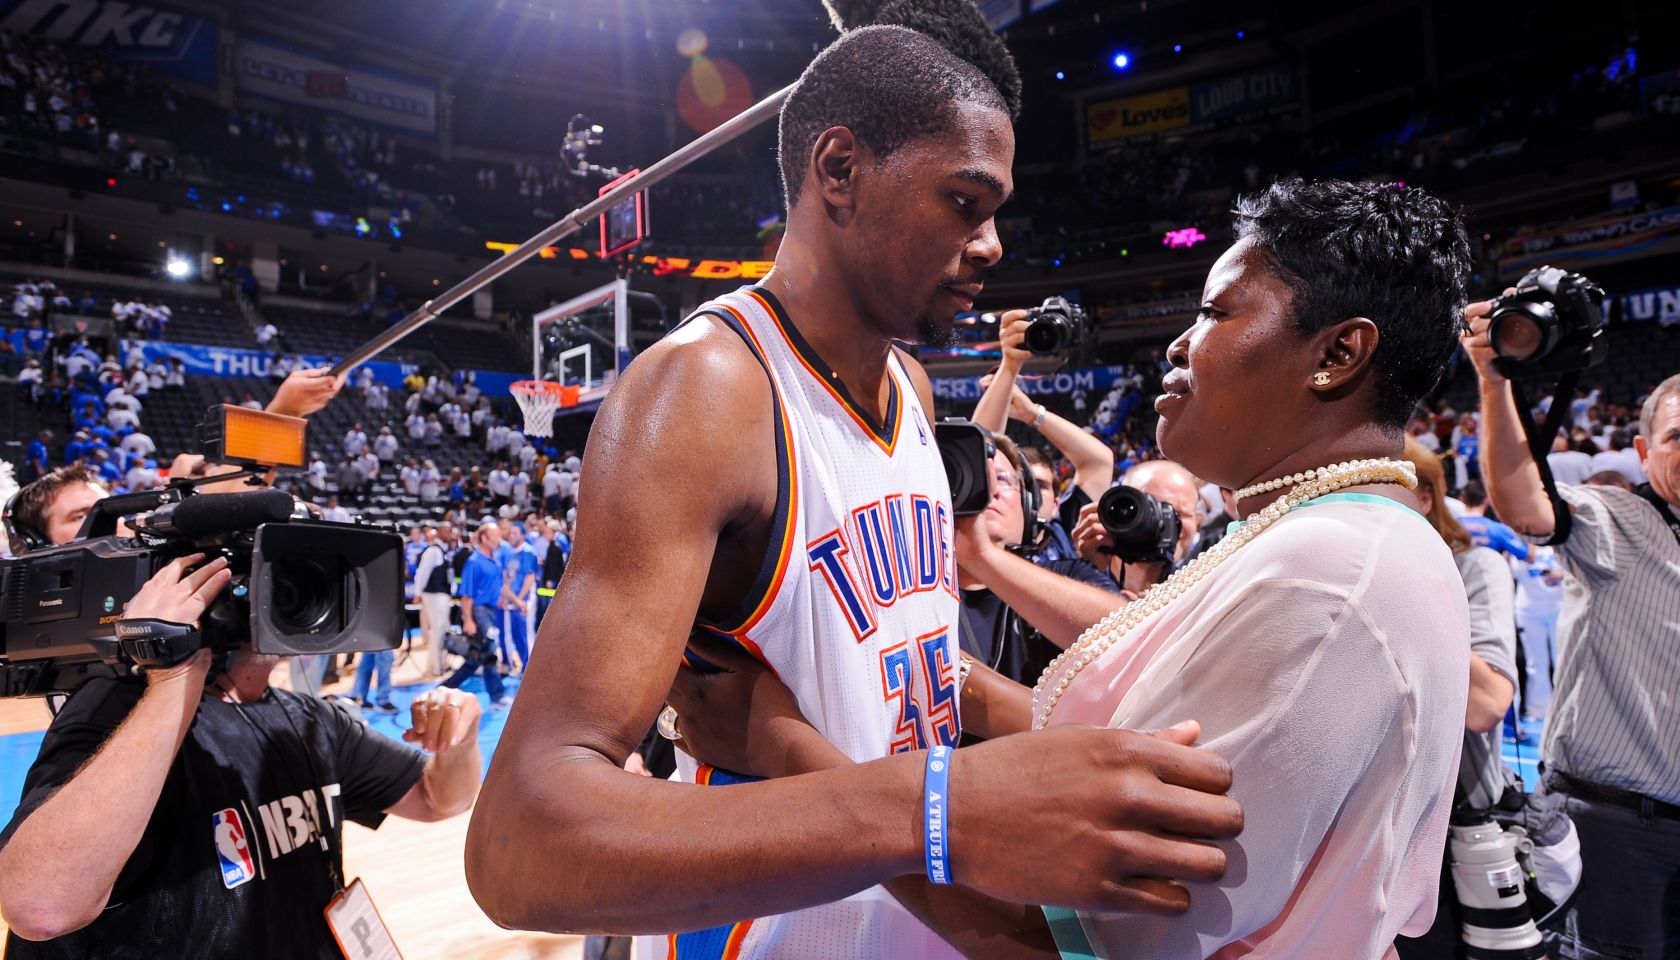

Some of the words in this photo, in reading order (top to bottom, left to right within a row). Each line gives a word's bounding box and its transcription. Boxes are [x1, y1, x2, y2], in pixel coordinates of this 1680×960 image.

[0, 0, 184, 46] OKC
[1198, 77, 1245, 117] LOUD
[1249, 71, 1291, 98] CITY
[119, 624, 152, 635] Canon
[880, 625, 962, 756] 35
[929, 789, 942, 803] A
[929, 803, 943, 857] TRUE
[225, 867, 243, 885] NBA
